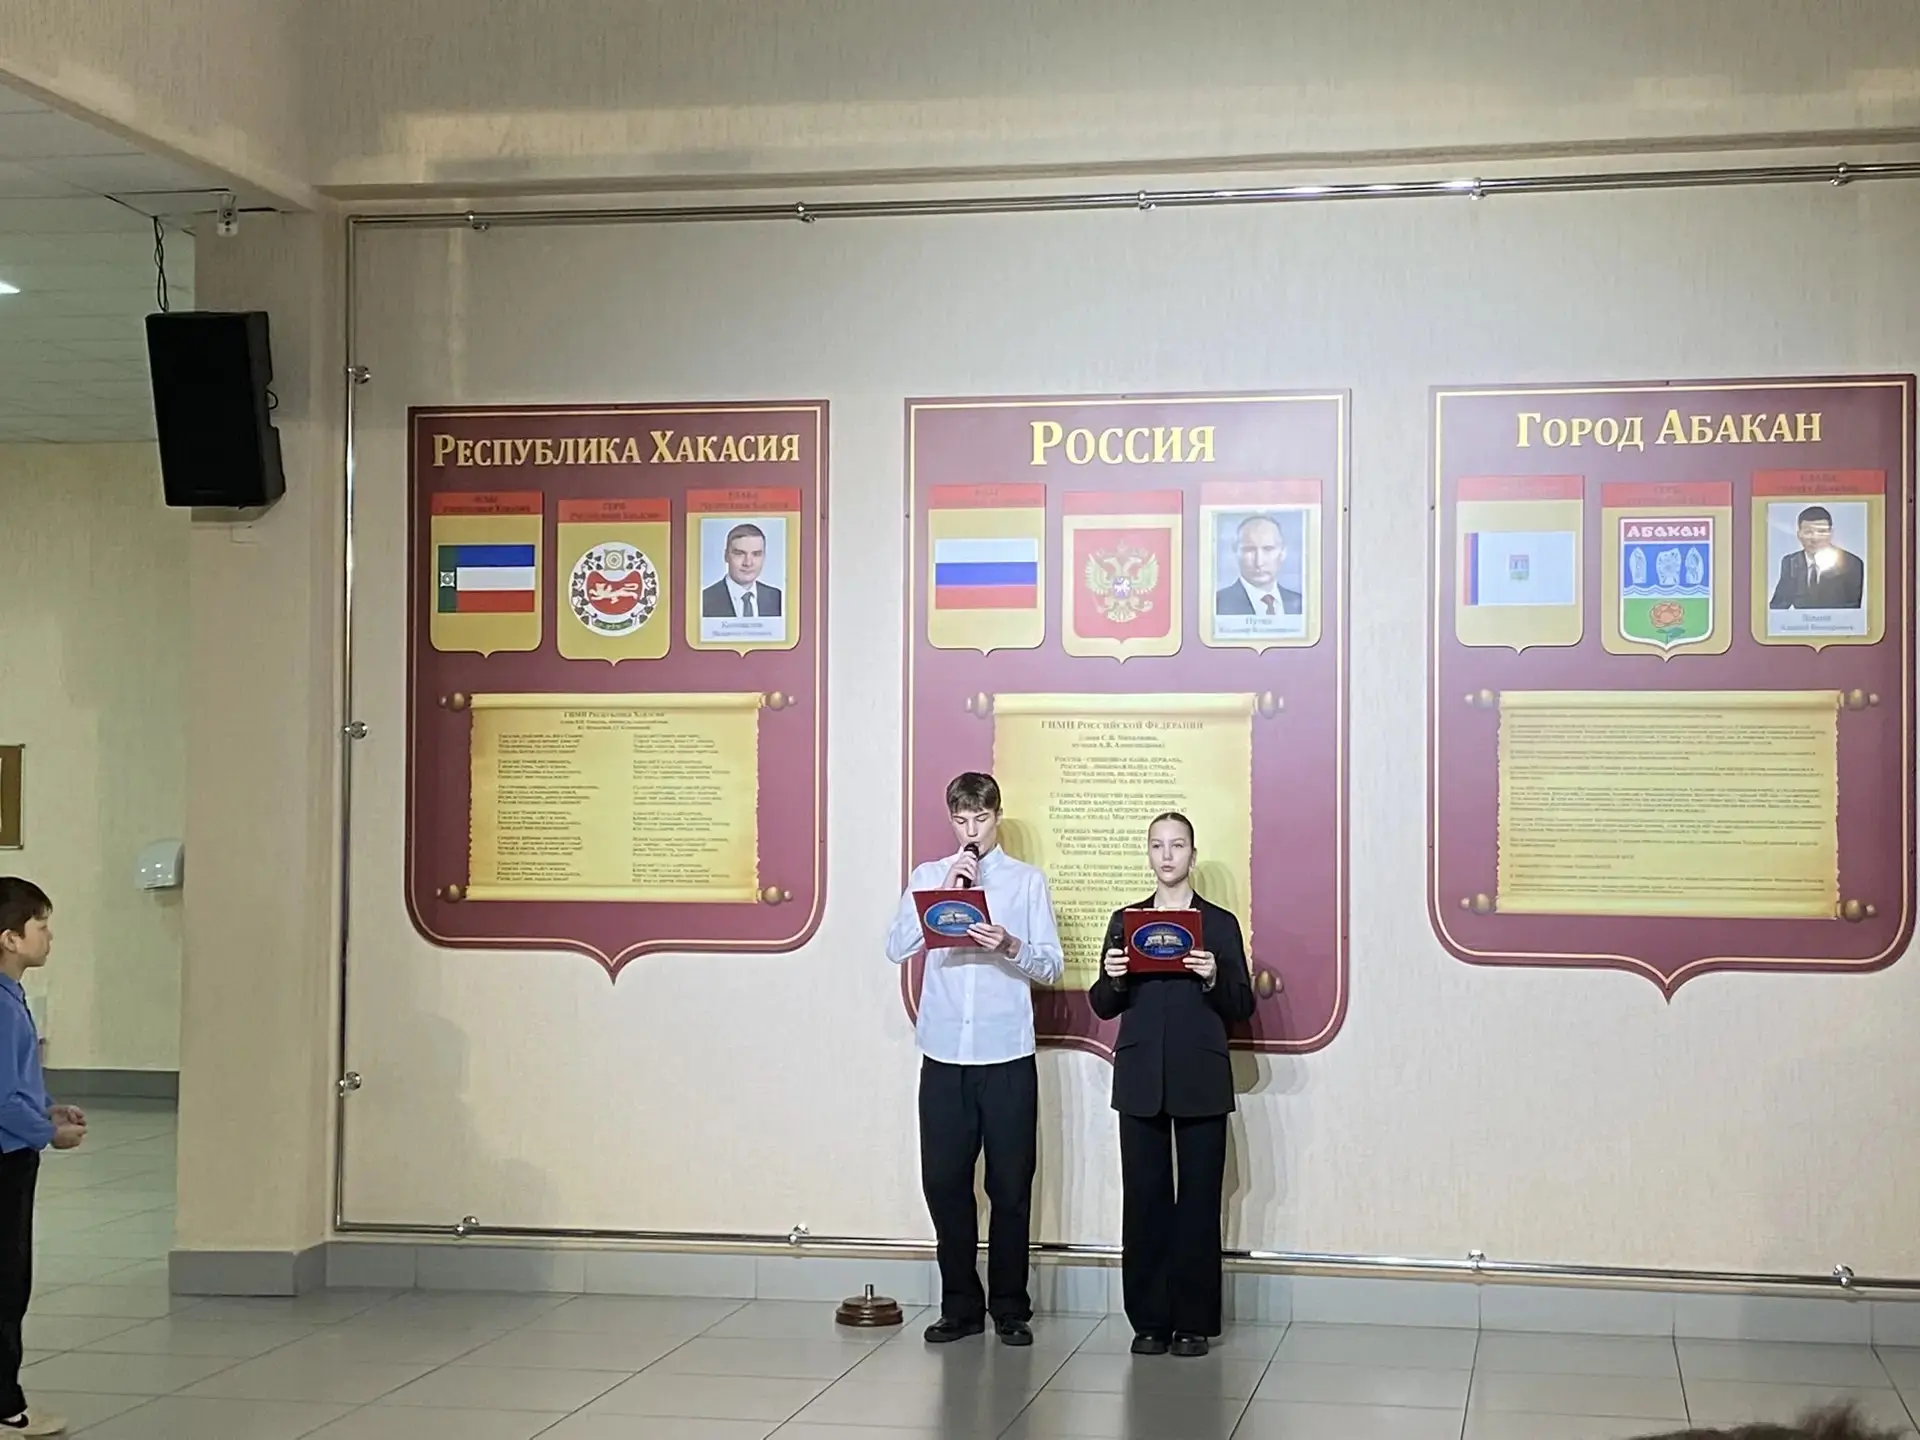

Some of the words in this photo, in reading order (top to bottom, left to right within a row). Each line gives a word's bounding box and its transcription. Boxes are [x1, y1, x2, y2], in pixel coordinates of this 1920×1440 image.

[432, 433, 641, 467] РЕСПУБЛИКА
[649, 430, 800, 465] ХАКАСИЯ
[1029, 420, 1217, 466] РОССИЯ
[1516, 412, 1644, 452] ГОРОД
[1654, 408, 1823, 445] АБАКАН
